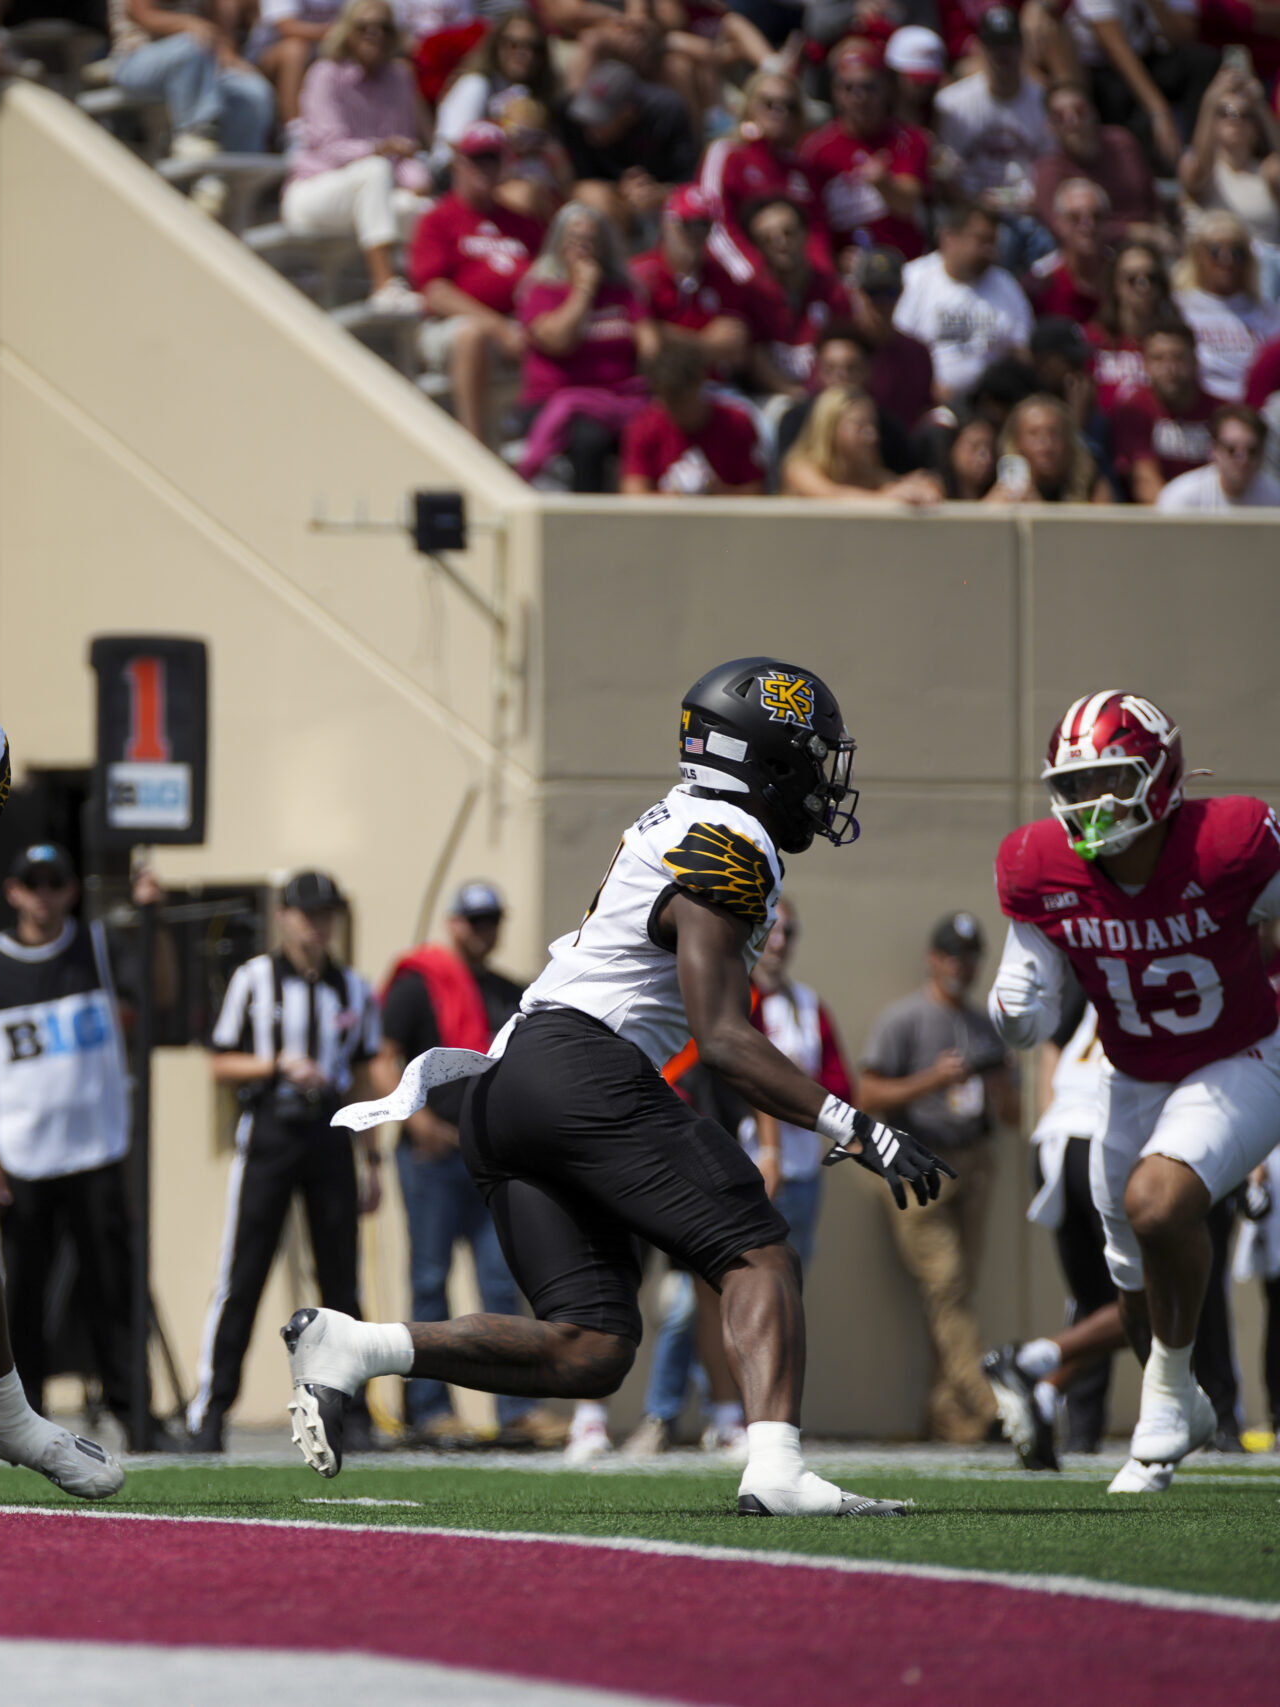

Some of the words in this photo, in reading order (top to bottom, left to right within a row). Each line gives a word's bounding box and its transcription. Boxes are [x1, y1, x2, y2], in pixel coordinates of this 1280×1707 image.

[122, 656, 173, 763] 1
[1061, 907, 1220, 951] INDIANA
[1096, 952, 1224, 1037] 13
